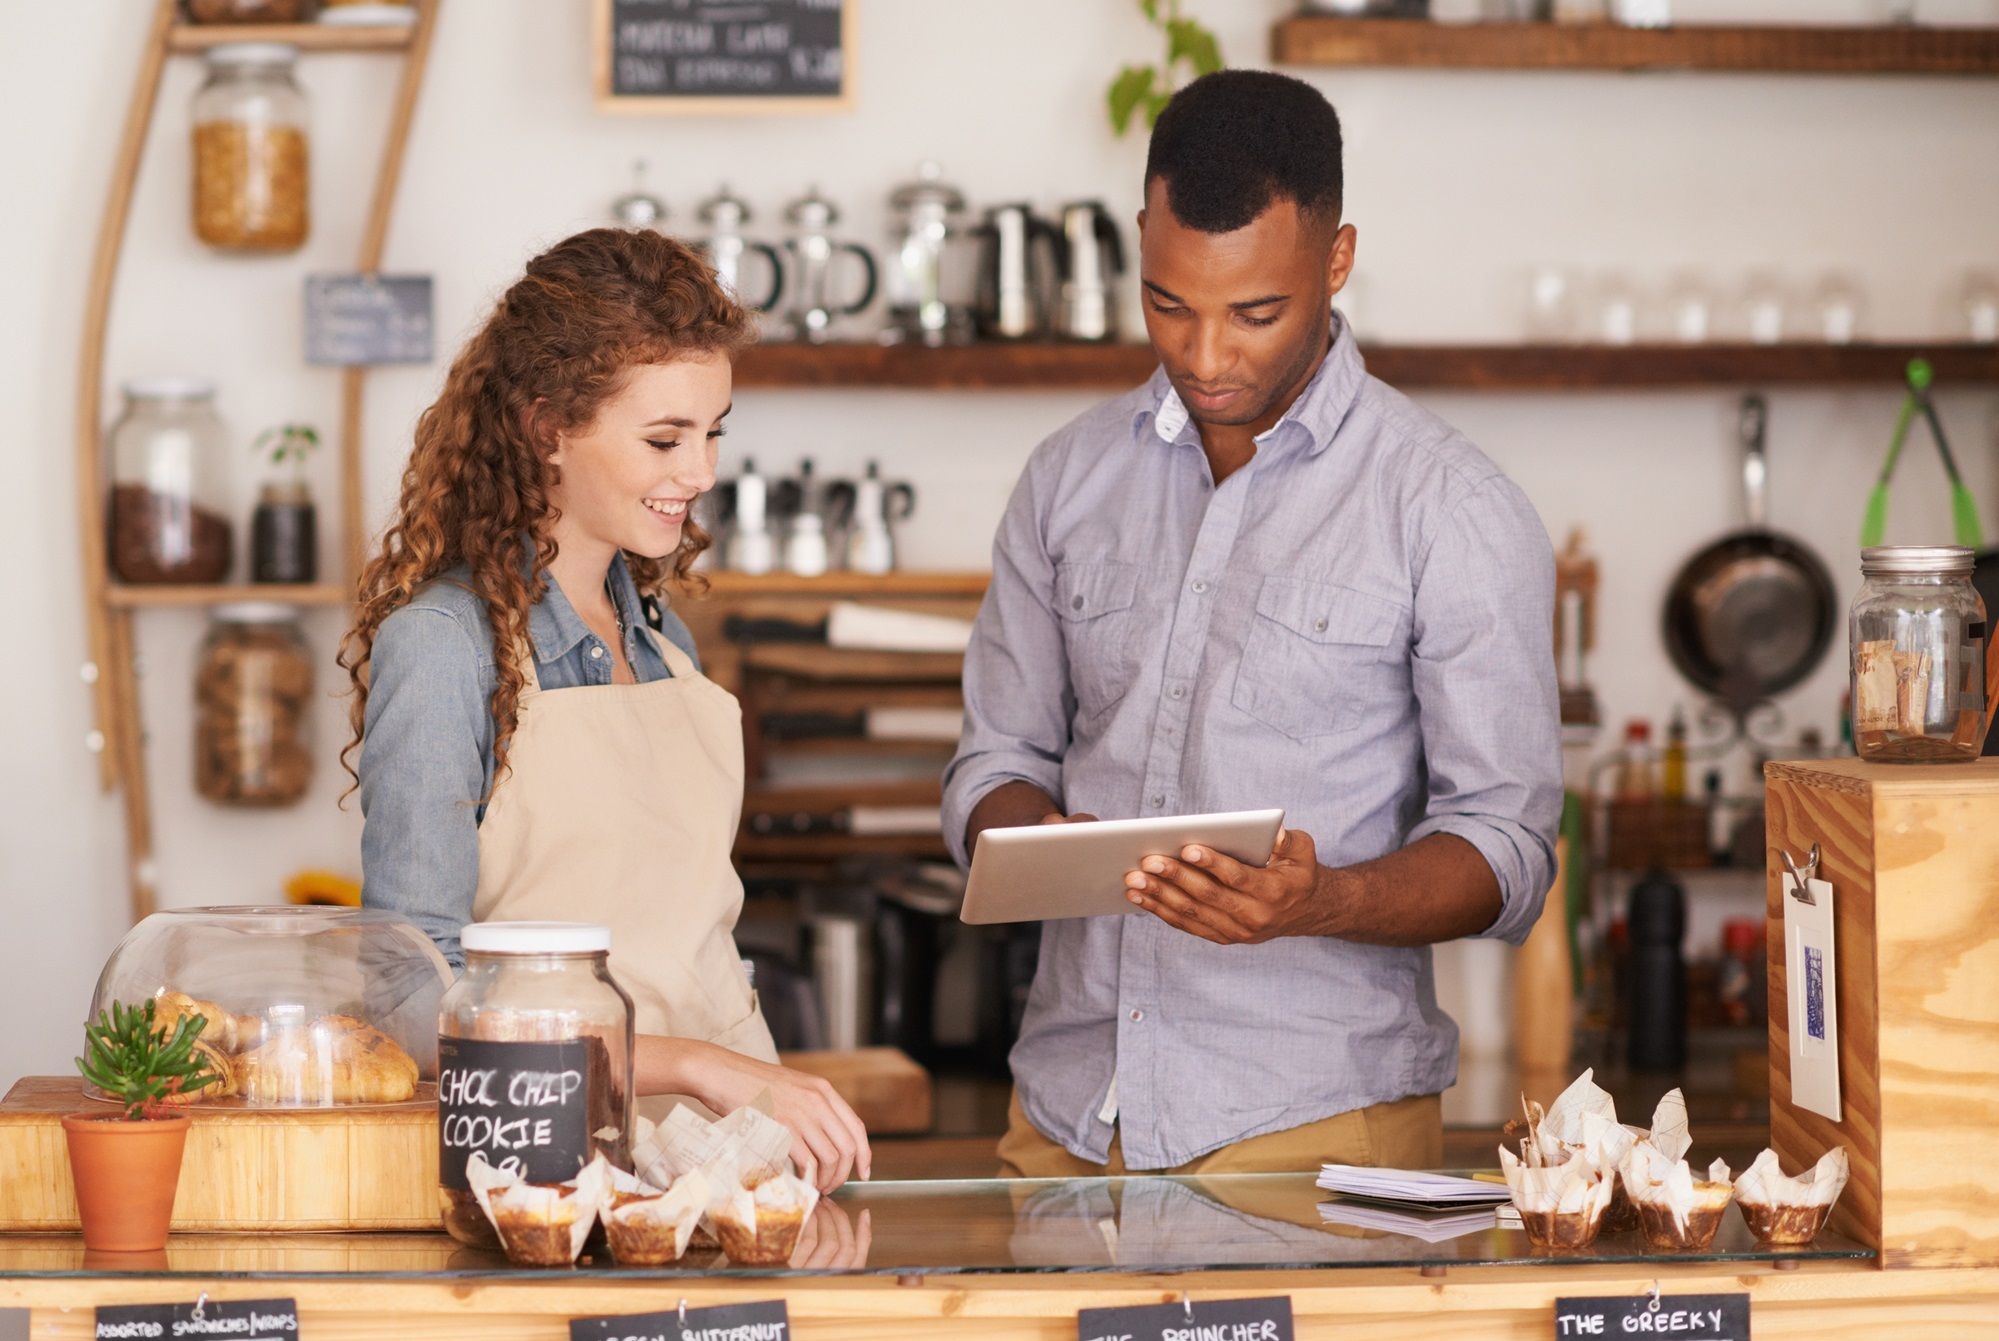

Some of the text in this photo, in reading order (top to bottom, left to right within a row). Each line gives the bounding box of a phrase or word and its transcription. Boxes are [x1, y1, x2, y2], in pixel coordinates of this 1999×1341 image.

[439, 1069, 582, 1107] CHOC CHIP
[443, 1114, 552, 1150] COOKIE
[96, 1321, 164, 1338] ASSORTED
[1558, 1308, 1722, 1335] THE GREEKY
